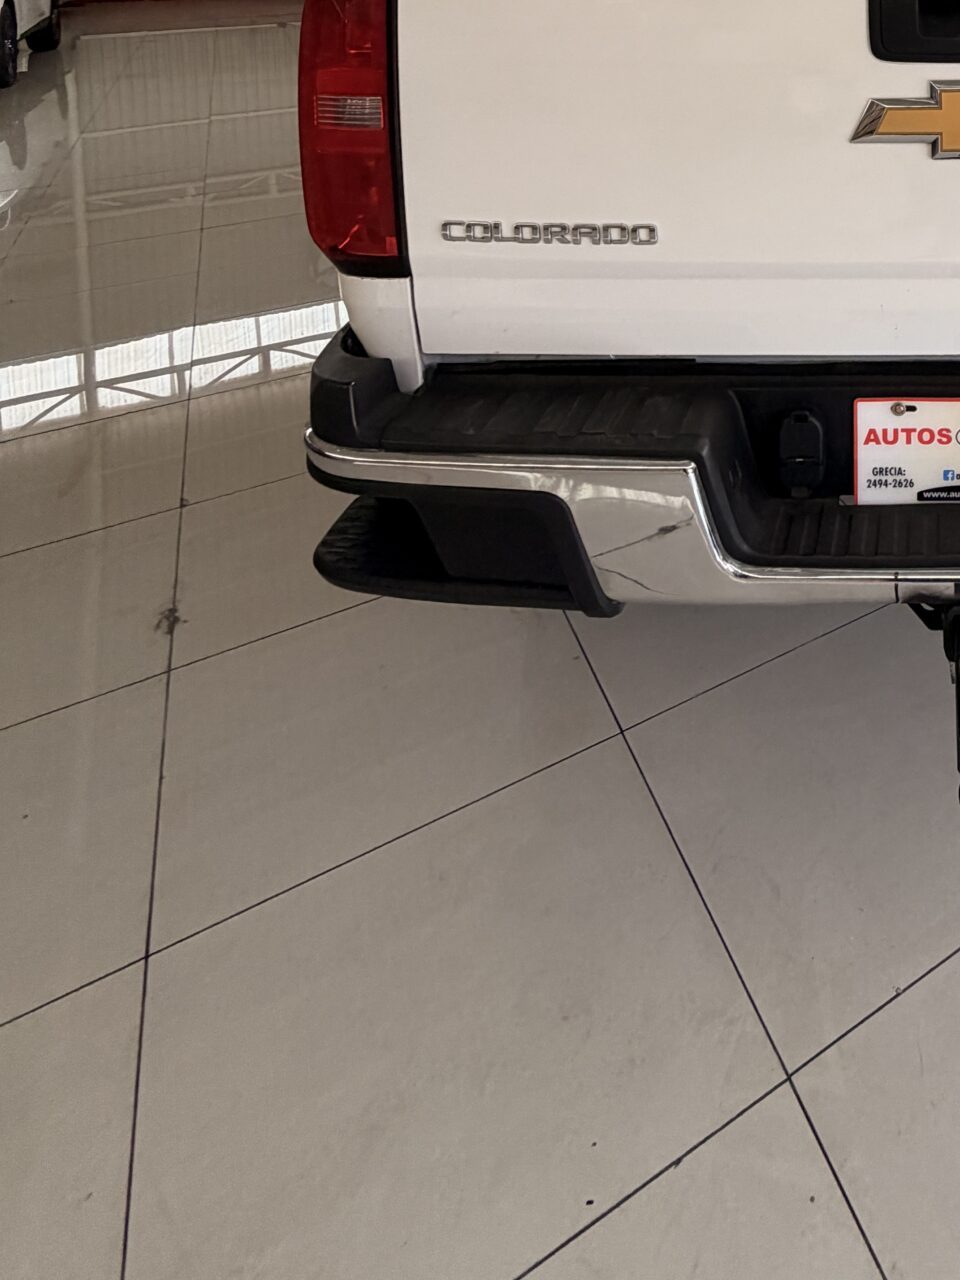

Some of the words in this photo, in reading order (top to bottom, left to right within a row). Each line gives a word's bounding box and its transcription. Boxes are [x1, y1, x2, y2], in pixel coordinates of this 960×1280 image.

[441, 220, 658, 245] COLORADO
[863, 427, 952, 445] AUTOS
[872, 467, 906, 476] GRECIA:
[866, 479, 914, 488] 2494-2626
